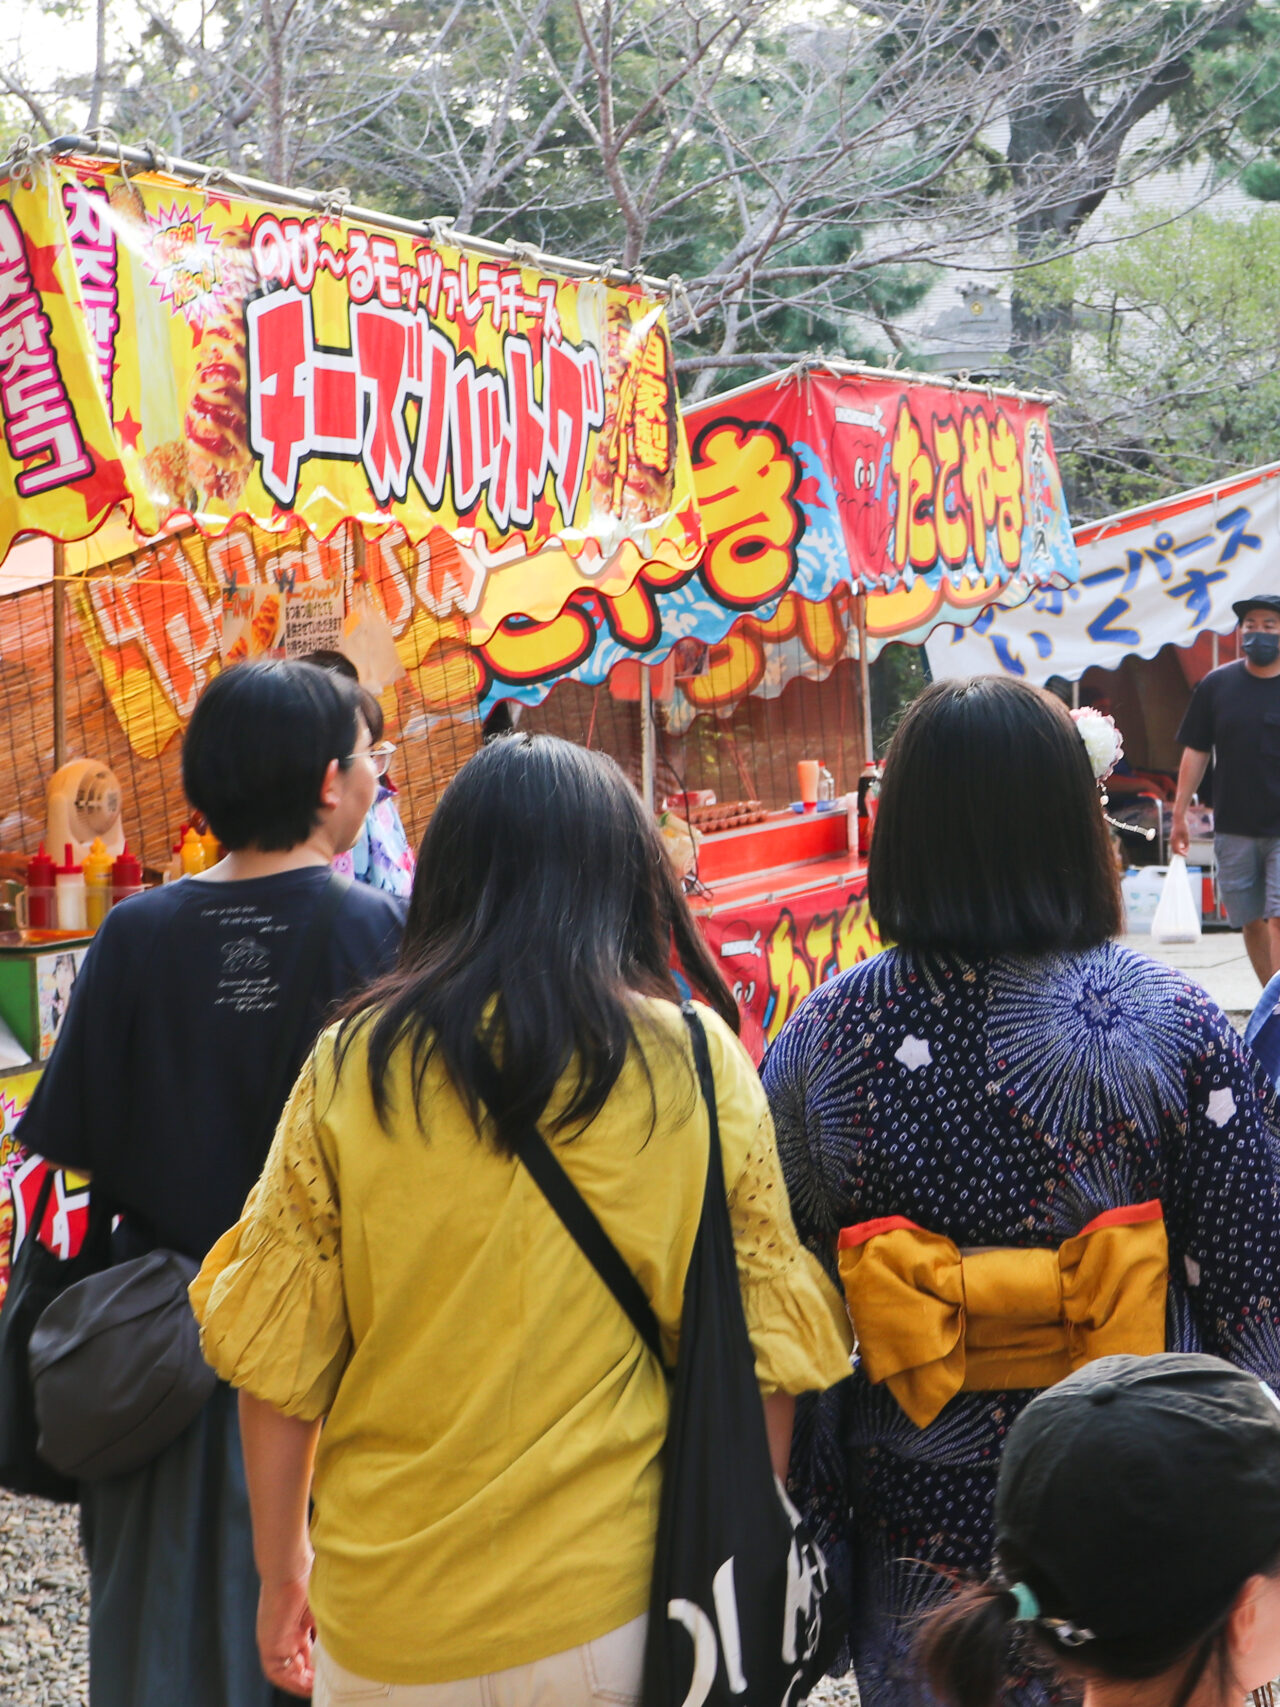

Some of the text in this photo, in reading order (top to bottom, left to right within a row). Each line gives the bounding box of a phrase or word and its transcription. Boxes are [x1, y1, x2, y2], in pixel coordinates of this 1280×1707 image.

[246, 288, 606, 531] チーズハットグ
[890, 394, 1023, 574] たこやき
